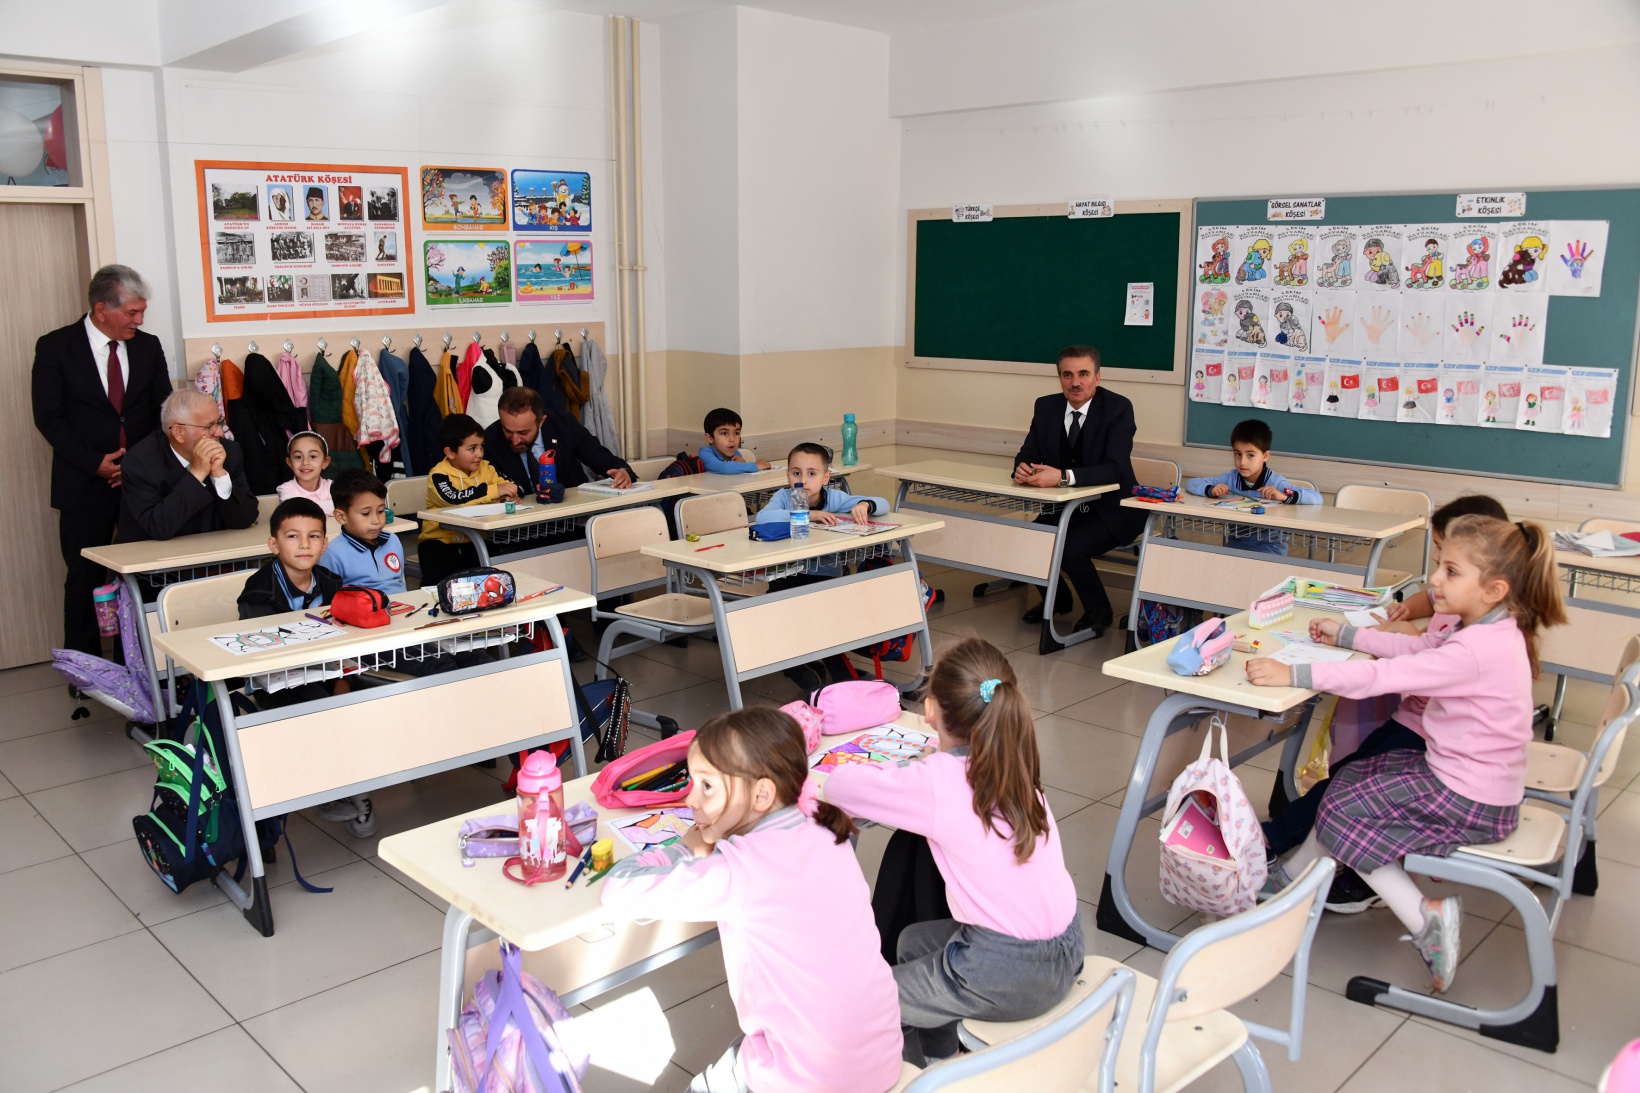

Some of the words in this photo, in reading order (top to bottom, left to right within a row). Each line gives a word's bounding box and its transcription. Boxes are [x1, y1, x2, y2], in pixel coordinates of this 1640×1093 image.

[266, 174, 315, 182] ATATÜRK
[318, 175, 352, 184] KÖŞESİ
[1286, 210, 1305, 219] KÖŞESİ
[1478, 206, 1502, 215] KÖŞESİ
